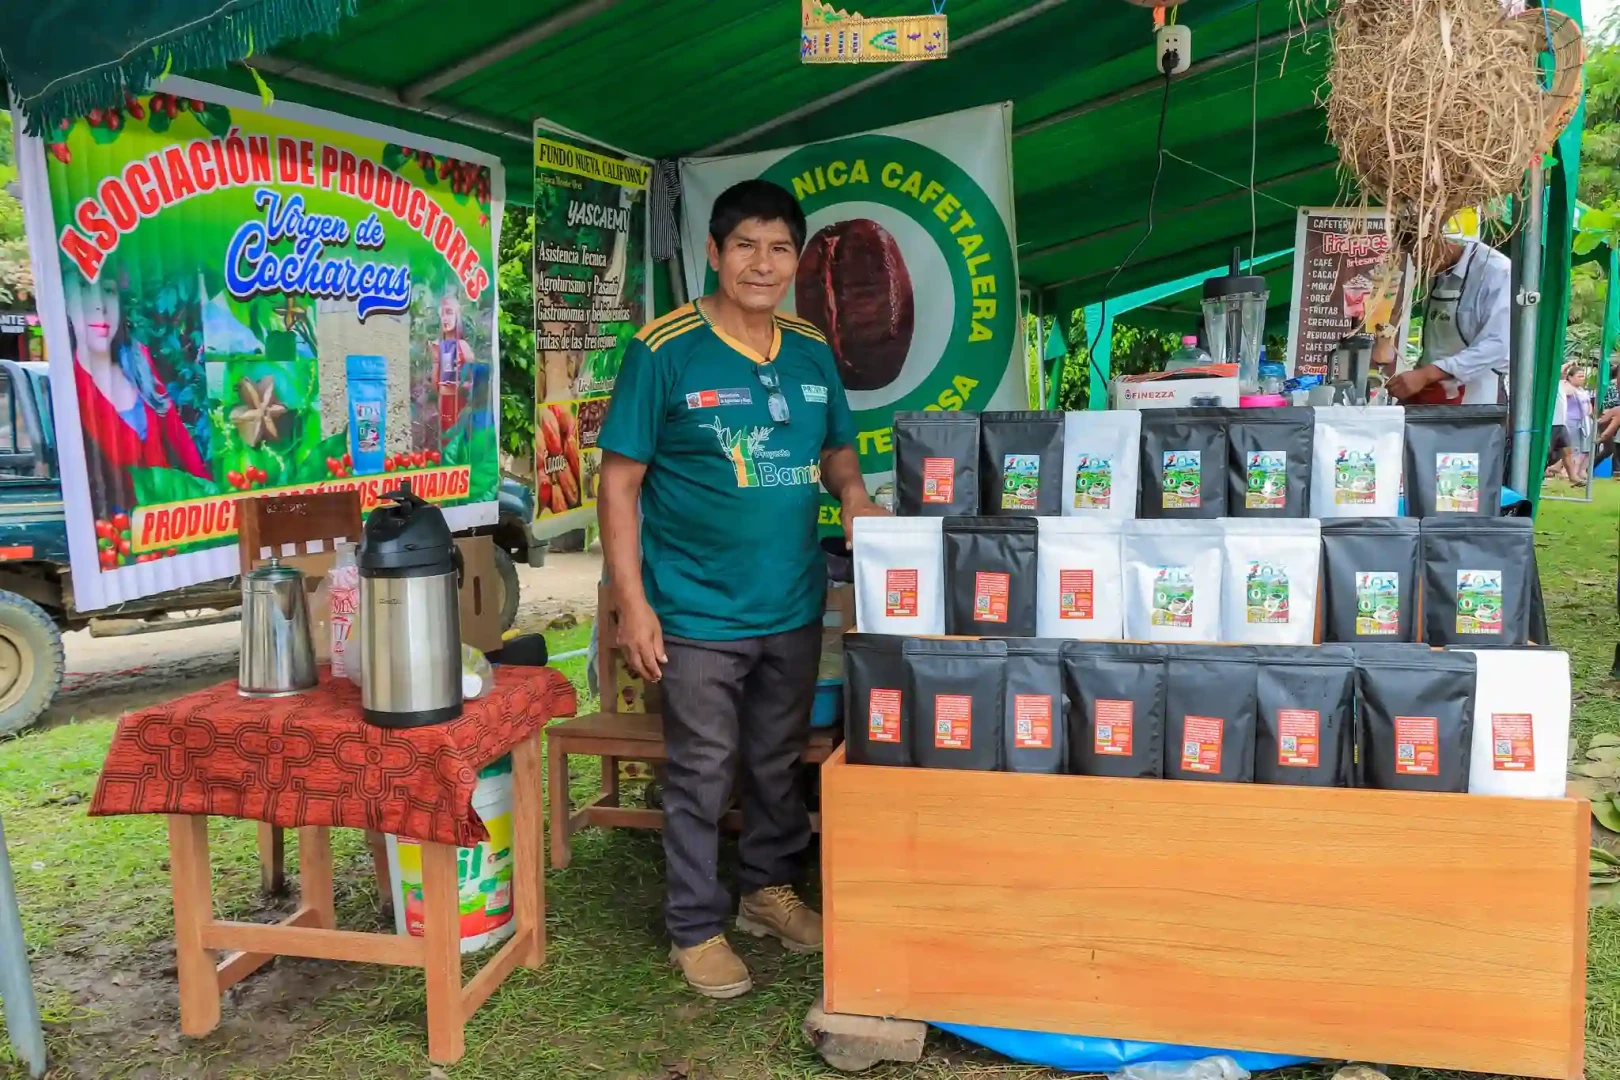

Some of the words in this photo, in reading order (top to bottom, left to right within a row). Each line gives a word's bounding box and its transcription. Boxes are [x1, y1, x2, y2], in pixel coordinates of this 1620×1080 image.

[540, 144, 574, 168] FUNDO
[575, 152, 600, 176] NUEVA
[60, 128, 271, 280] ASOCIACIÓN
[277, 137, 315, 185] DE
[322, 144, 488, 299] PRODUCTORES
[255, 188, 348, 256] Virgen
[355, 212, 385, 247] de
[539, 240, 579, 265] Asistencia
[581, 245, 607, 267] Tecnica
[791, 159, 870, 200] NICA
[881, 162, 997, 343] CAFETALERA
[1323, 232, 1391, 257] Frappes
[225, 220, 411, 319] Cocharcas
[1312, 270, 1337, 279] CACAO
[1313, 258, 1333, 267] CAFÉ
[538, 271, 585, 295] Agroturismo
[587, 281, 593, 297] y
[1309, 306, 1338, 315] FRUTAS
[536, 329, 560, 350] Frutas
[561, 329, 570, 349] de
[571, 329, 583, 349] las
[926, 375, 979, 411] SA
[1132, 391, 1174, 400] FINEZZA
[856, 427, 893, 455] TE
[140, 497, 255, 546] PRODUCT
[818, 505, 842, 525] EX
